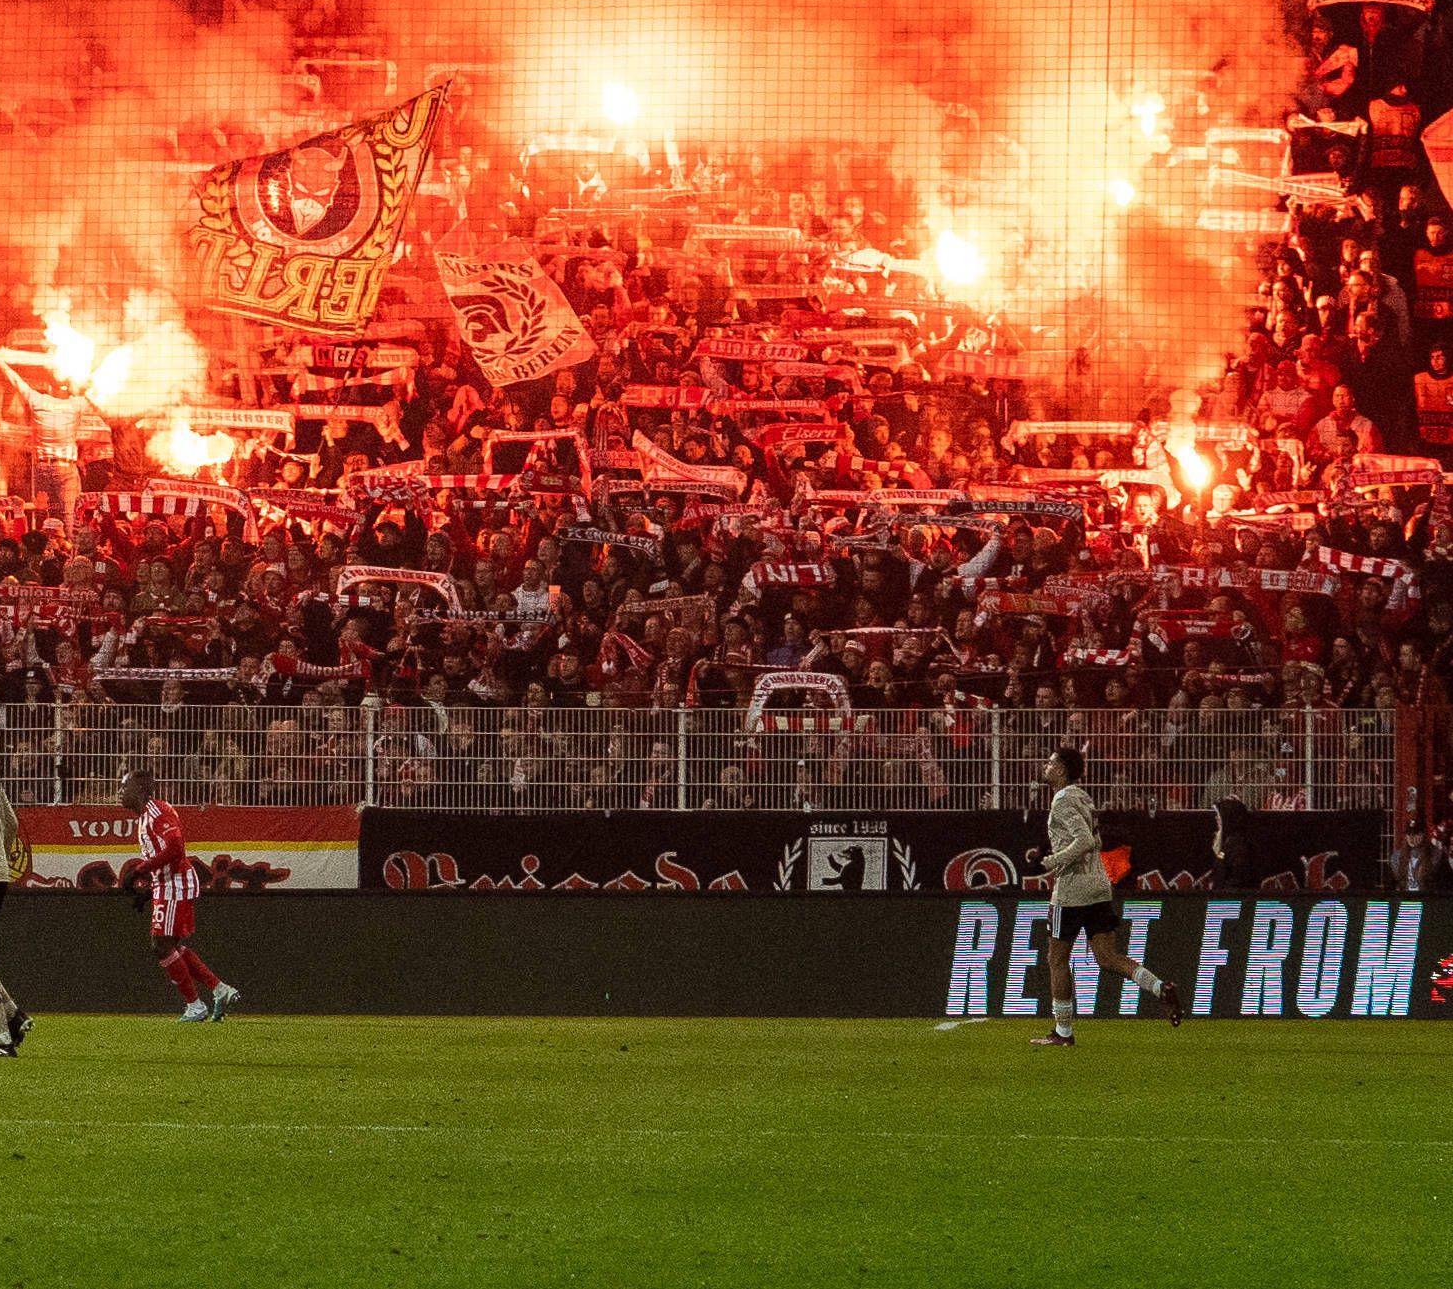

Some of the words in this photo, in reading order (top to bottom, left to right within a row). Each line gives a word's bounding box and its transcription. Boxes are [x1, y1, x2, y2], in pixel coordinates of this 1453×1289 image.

[781, 426, 836, 441] Eisern
[1034, 501, 1082, 520] UNION
[587, 529, 626, 543] UNION
[7, 585, 55, 597] Union
[446, 609, 500, 621] UNION
[297, 660, 363, 676] UNIONER
[809, 821, 846, 834] since
[1192, 900, 1424, 1017] FROM
